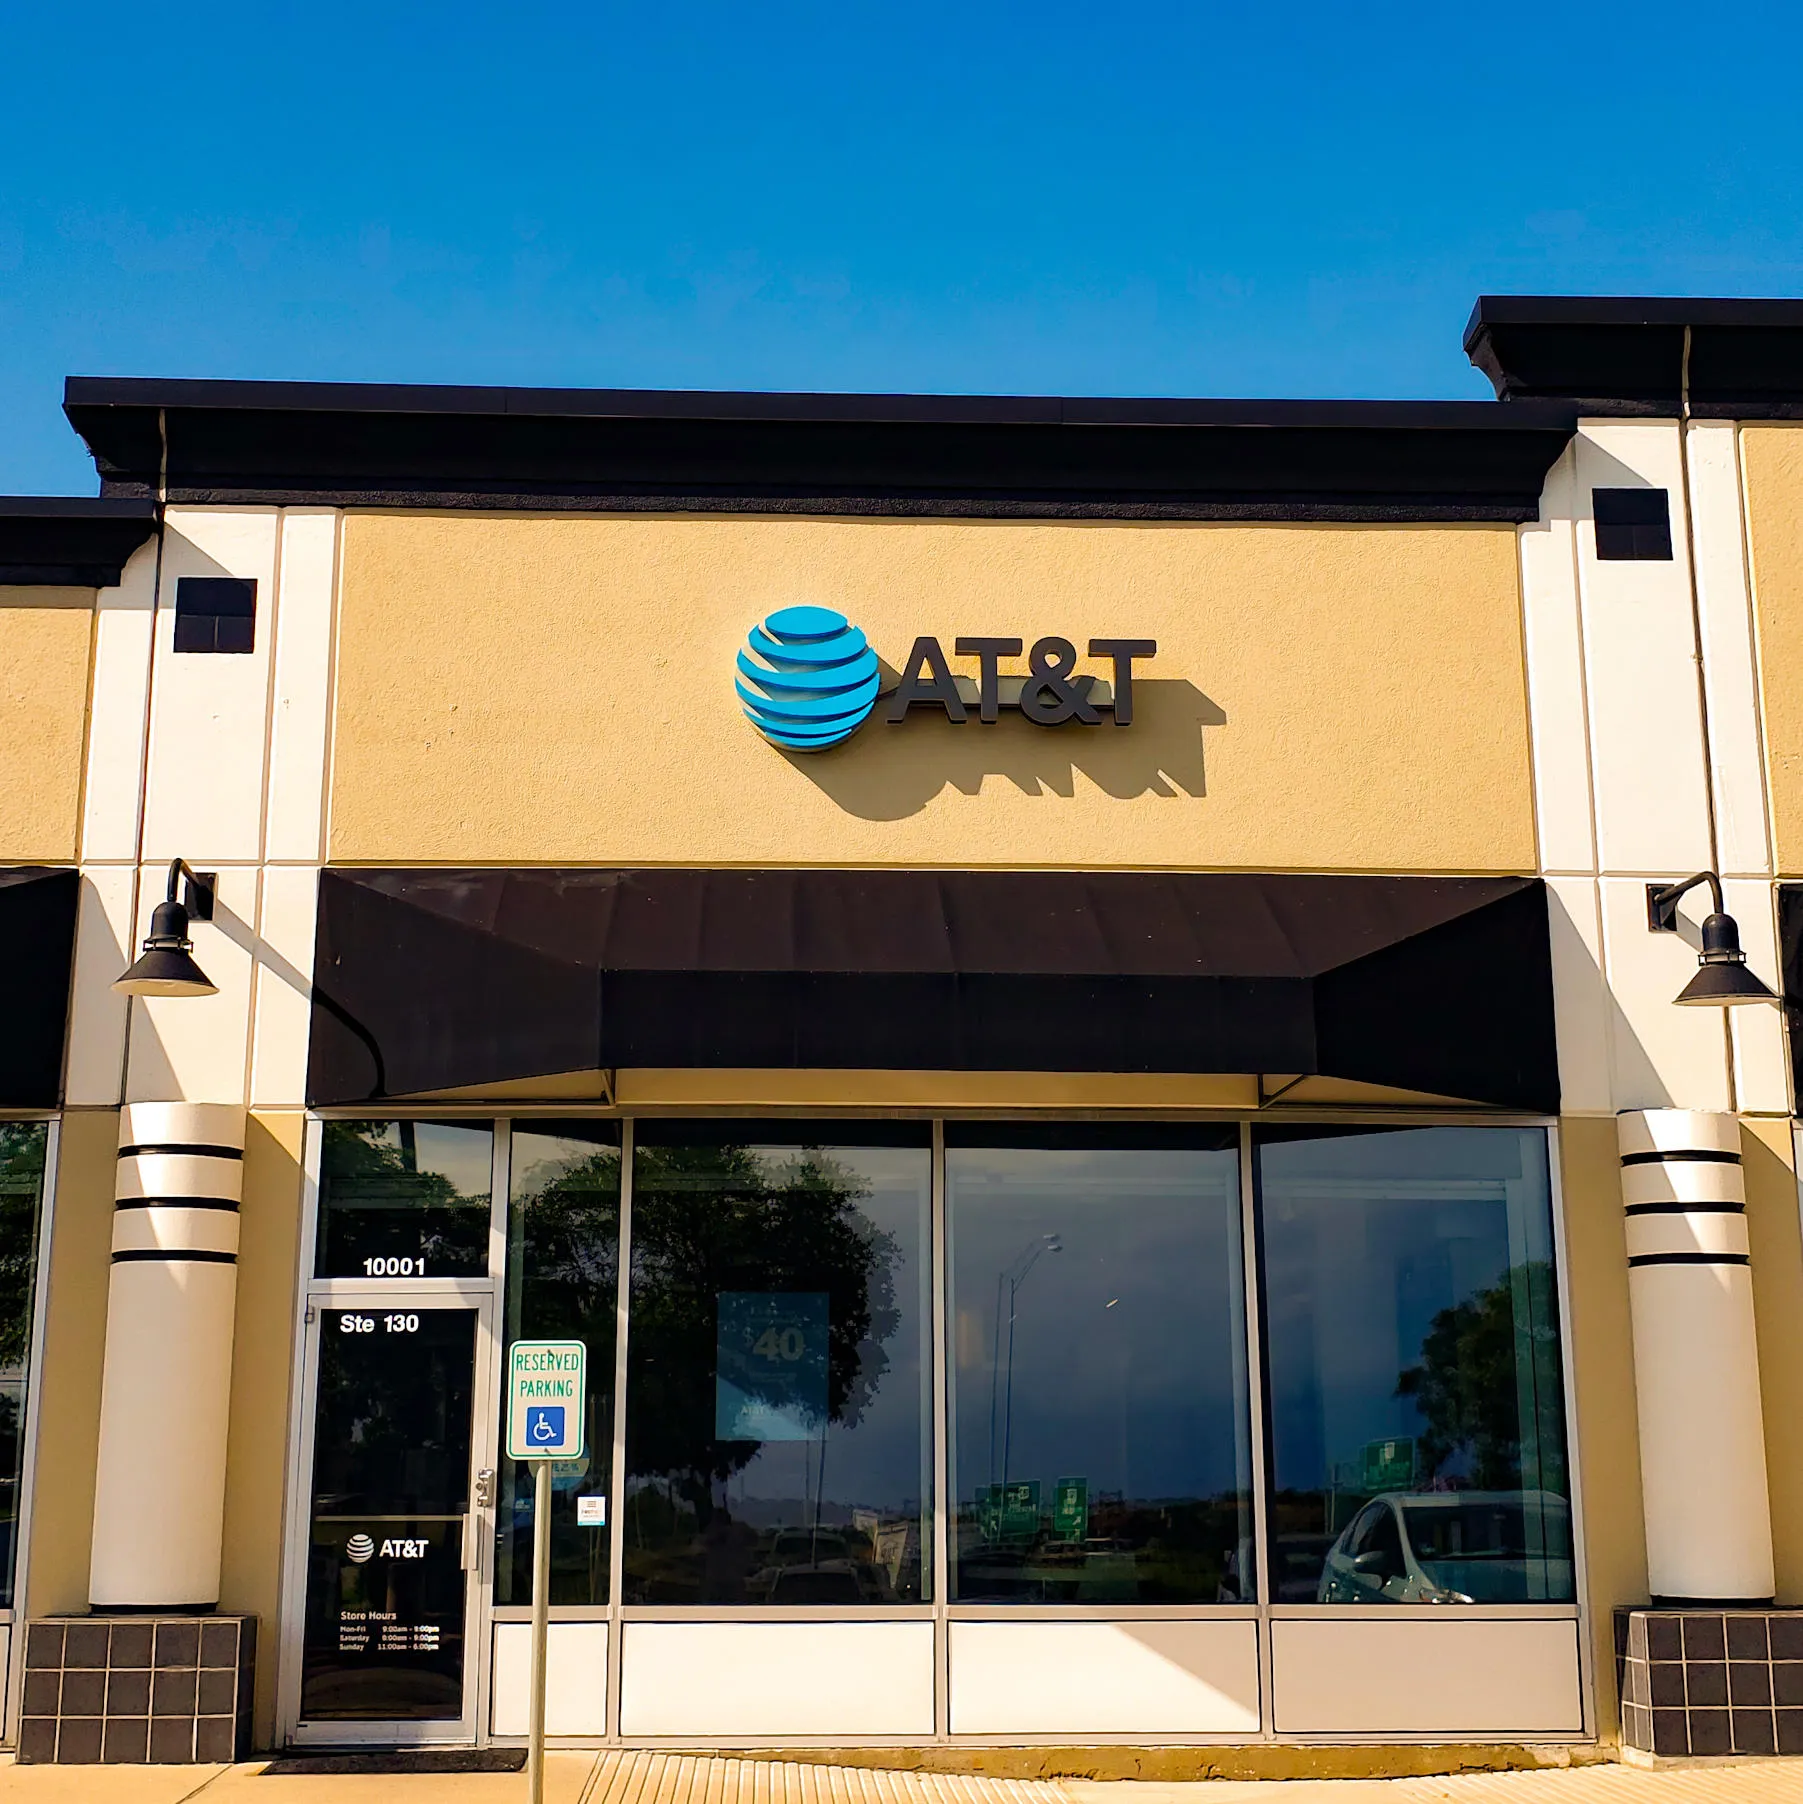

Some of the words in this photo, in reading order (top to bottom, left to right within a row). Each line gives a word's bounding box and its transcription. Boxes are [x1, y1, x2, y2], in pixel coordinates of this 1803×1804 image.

[887, 636, 1156, 726] AT&T
[363, 1257, 425, 1276] 10001
[340, 1315, 375, 1333] Ste
[383, 1314, 419, 1333] 130
[516, 1353, 579, 1371] RESERVED
[520, 1380, 573, 1397] PARKING
[379, 1539, 429, 1558] AT&T
[340, 1611, 366, 1621] Store
[368, 1611, 397, 1621] Hours
[339, 1643, 364, 1652] Sunday
[340, 1634, 370, 1643] Saturday
